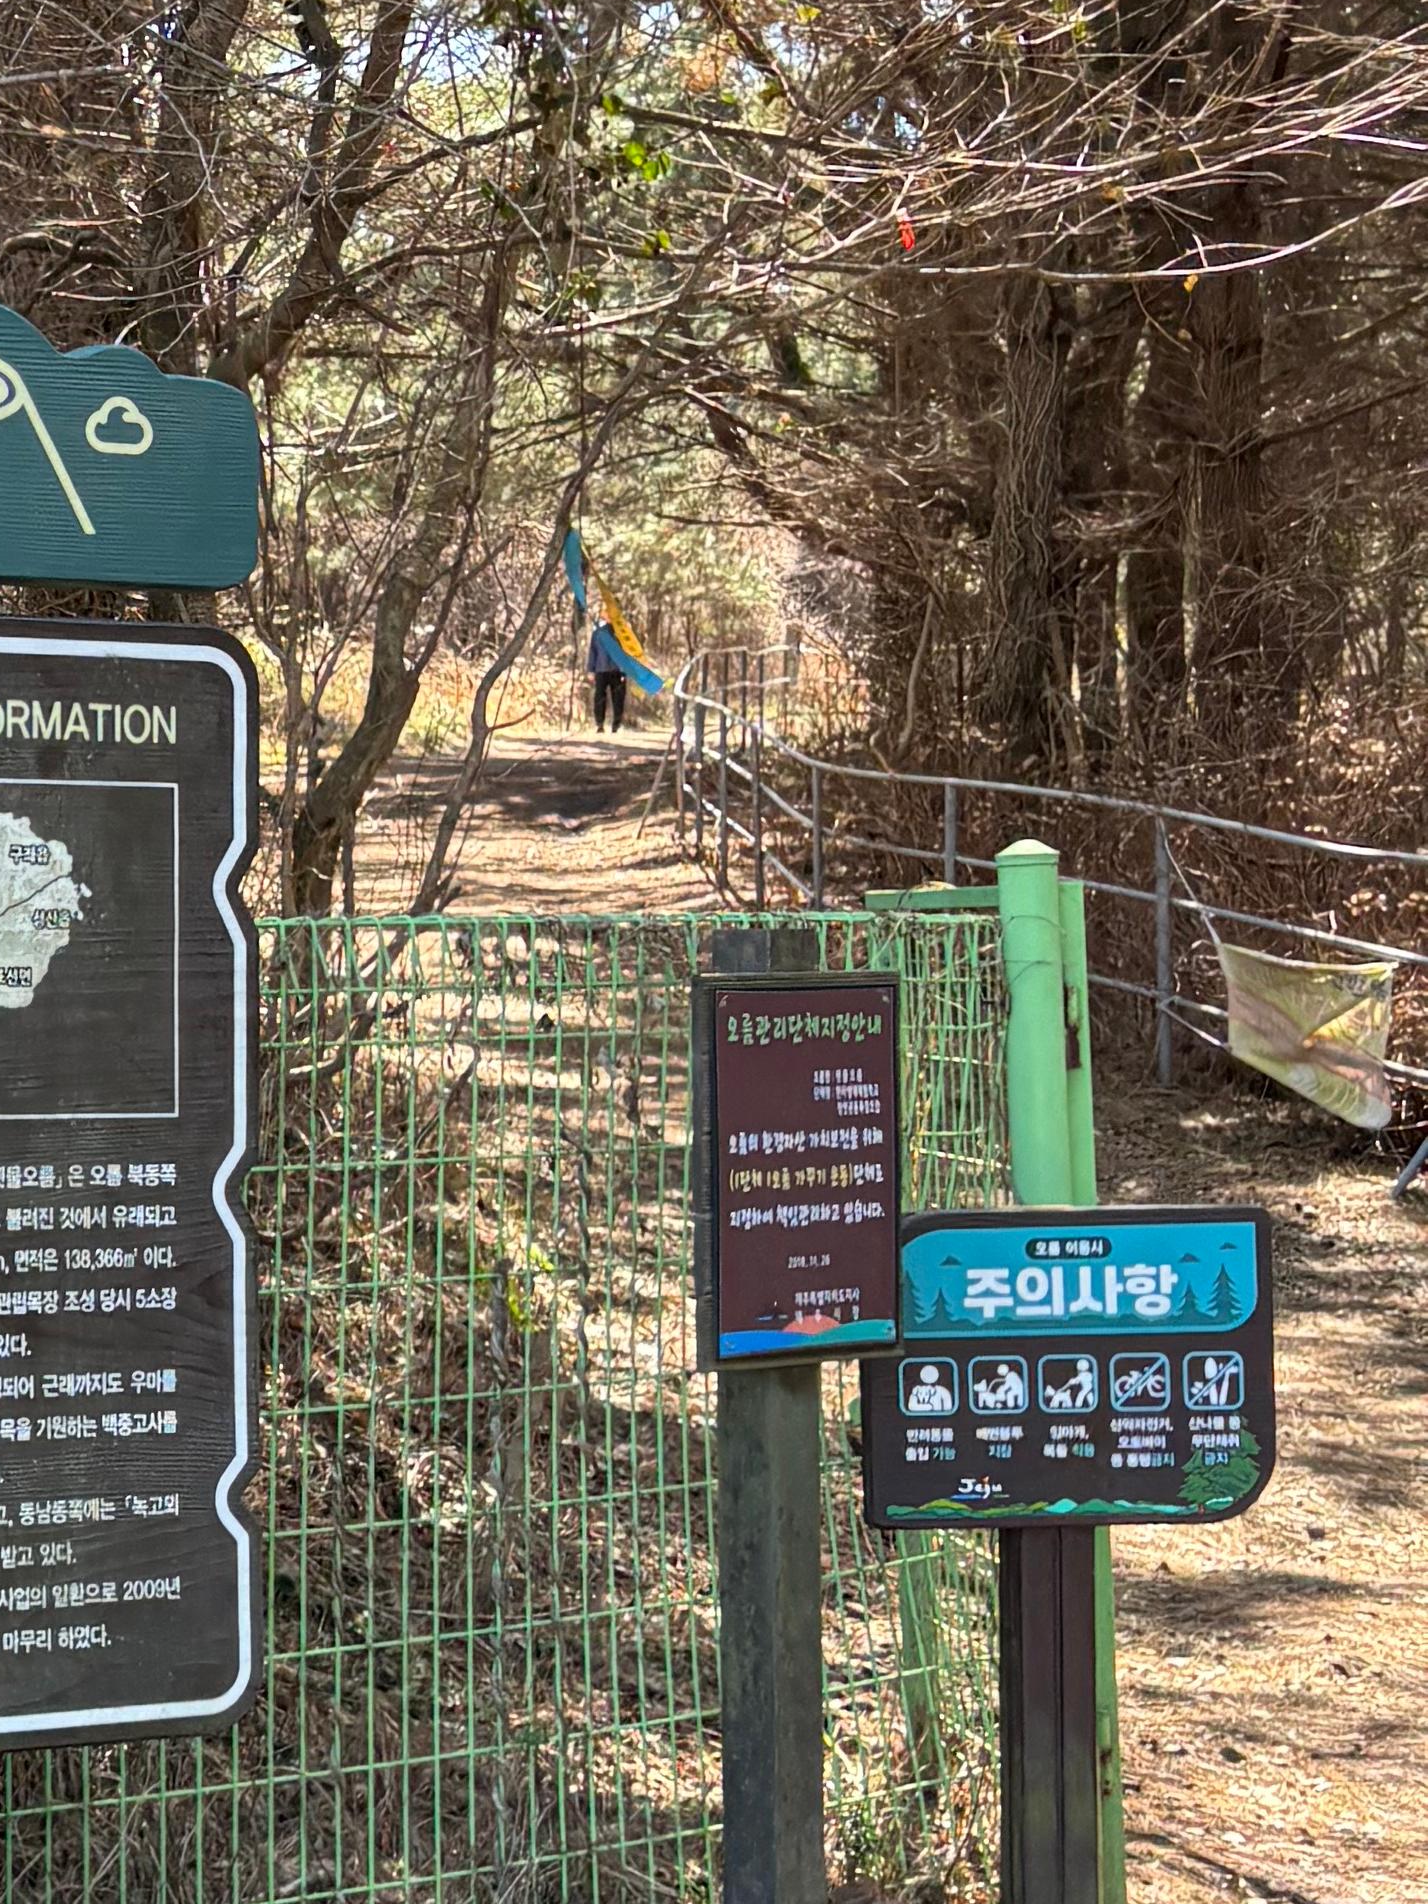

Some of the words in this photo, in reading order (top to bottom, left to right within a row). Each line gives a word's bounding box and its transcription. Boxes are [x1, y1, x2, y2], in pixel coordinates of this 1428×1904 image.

[89, 1163, 123, 1187] 오름
[127, 1163, 177, 1187] 북동쪽
[59, 1205, 107, 1230] 것에서
[112, 1204, 178, 1228] 유래되고
[143, 1245, 177, 1269] 이다.
[63, 1288, 95, 1313] 조성
[99, 1287, 131, 1313] 당시
[135, 1286, 178, 1311] 5소장
[964, 1264, 1178, 1319] 주의사항
[957, 1476, 1002, 1498] Jeju
[39, 1541, 77, 1566] 있다.
[122, 1575, 181, 1601] 2009년
[2, 1627, 52, 1654] 마무리
